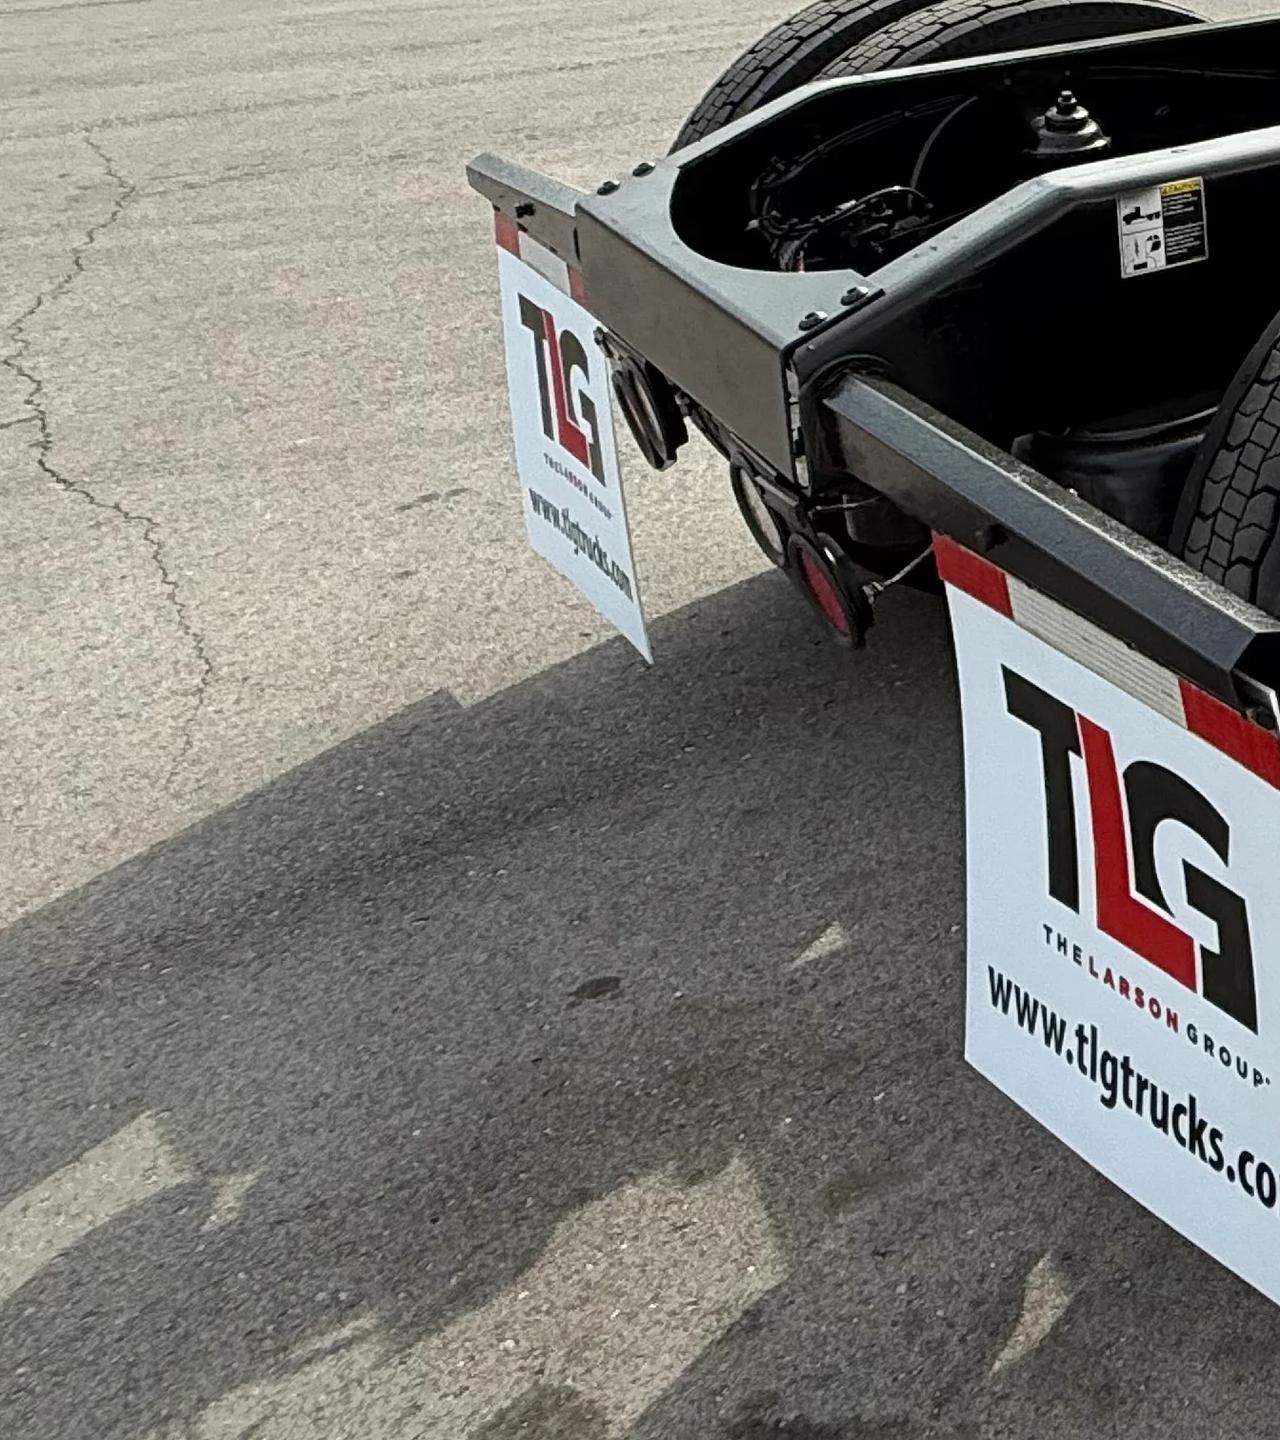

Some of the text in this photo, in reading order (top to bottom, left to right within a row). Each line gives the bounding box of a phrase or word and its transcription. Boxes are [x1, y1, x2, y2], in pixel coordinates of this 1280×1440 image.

[518, 293, 606, 486] TLG
[1001, 663, 1258, 1035] TLG
[1043, 924, 1264, 1088] THE LARSON GROUP
